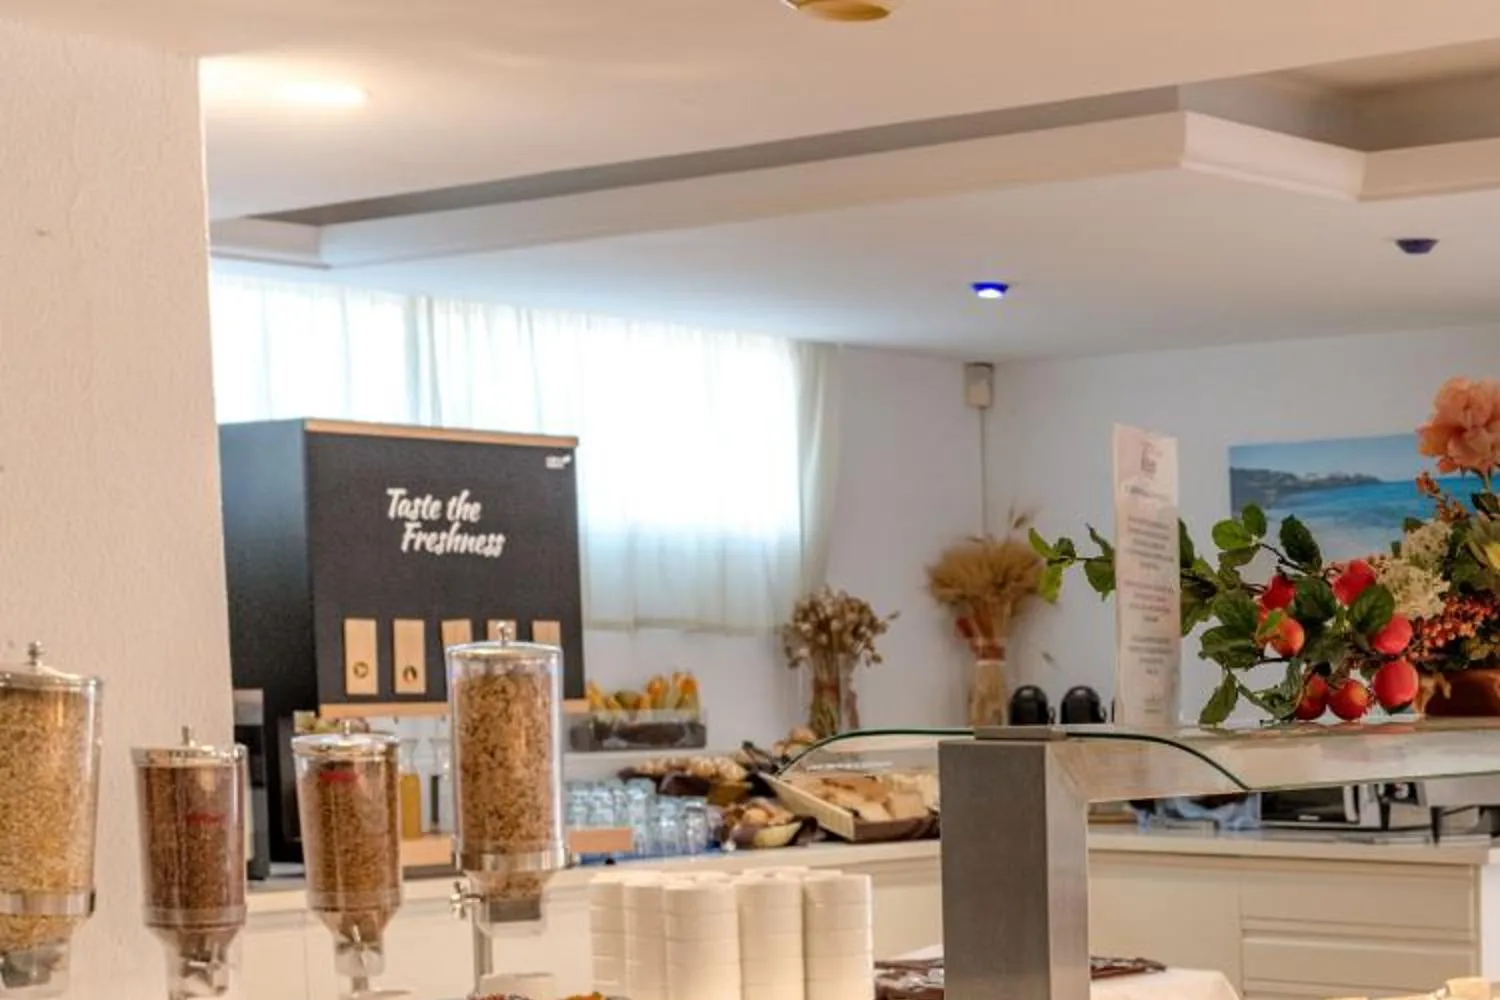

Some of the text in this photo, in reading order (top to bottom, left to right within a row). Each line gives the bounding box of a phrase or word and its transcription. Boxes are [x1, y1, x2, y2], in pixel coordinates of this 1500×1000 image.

[386, 488, 481, 522] Taste the
[401, 522, 505, 557] Freshness
